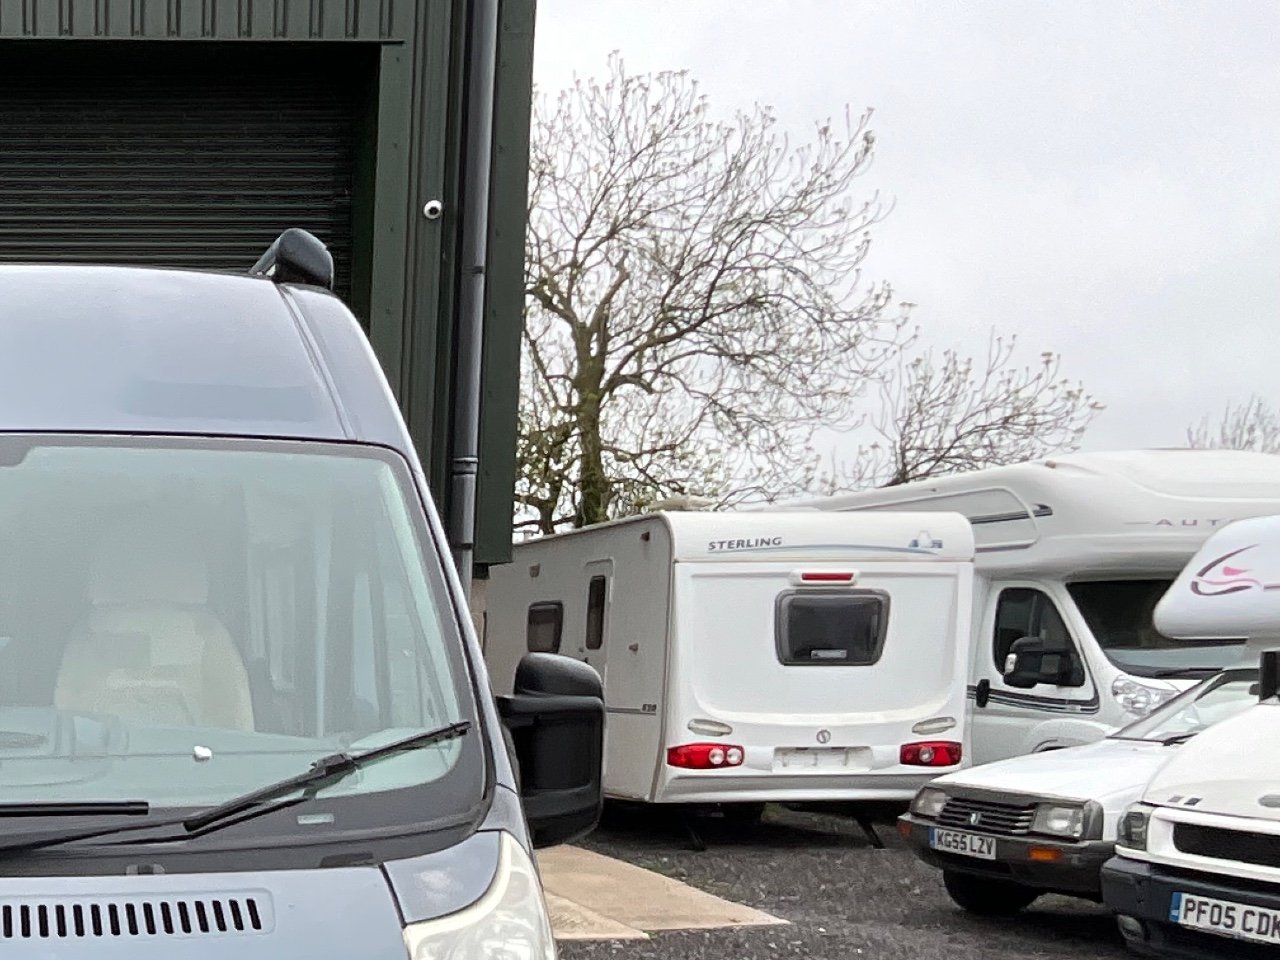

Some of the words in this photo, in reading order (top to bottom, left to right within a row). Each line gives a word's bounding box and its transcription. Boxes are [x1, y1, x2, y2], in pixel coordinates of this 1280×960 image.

[708, 536, 783, 550] STERLING
[937, 829, 967, 851] KG55
[970, 835, 993, 856] LZY
[1183, 898, 1236, 929] PF05
[1242, 909, 1280, 938] CDK
